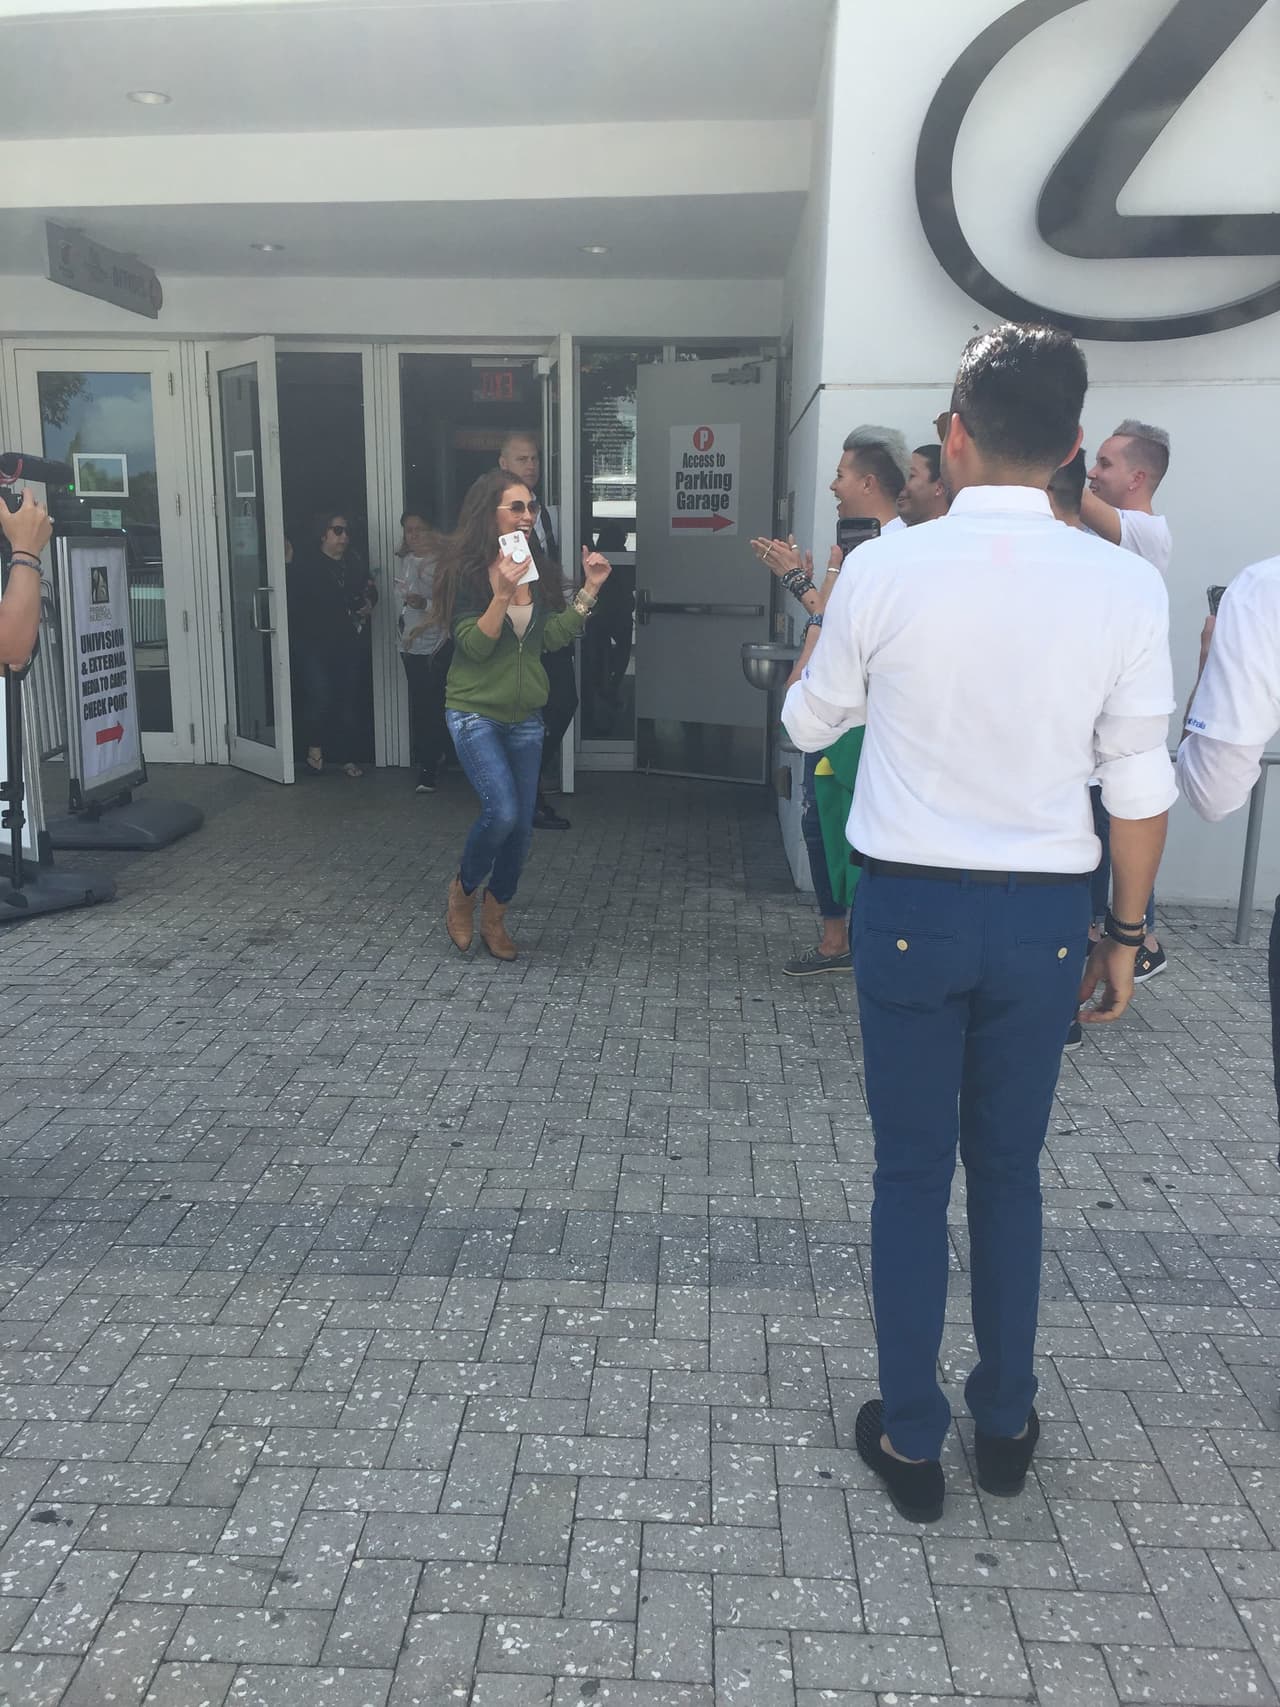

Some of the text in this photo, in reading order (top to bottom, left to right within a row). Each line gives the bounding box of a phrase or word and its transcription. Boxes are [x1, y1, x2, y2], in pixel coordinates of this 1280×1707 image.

[683, 452, 726, 468] Access to
[675, 470, 732, 491] Parking
[676, 491, 730, 512] Garage
[80, 628, 125, 654] UNIVISION
[81, 650, 127, 676] & EXTERNAL
[82, 678, 100, 697] MEDIA
[100, 676, 109, 692] TO
[83, 692, 128, 720] CHECK POINT
